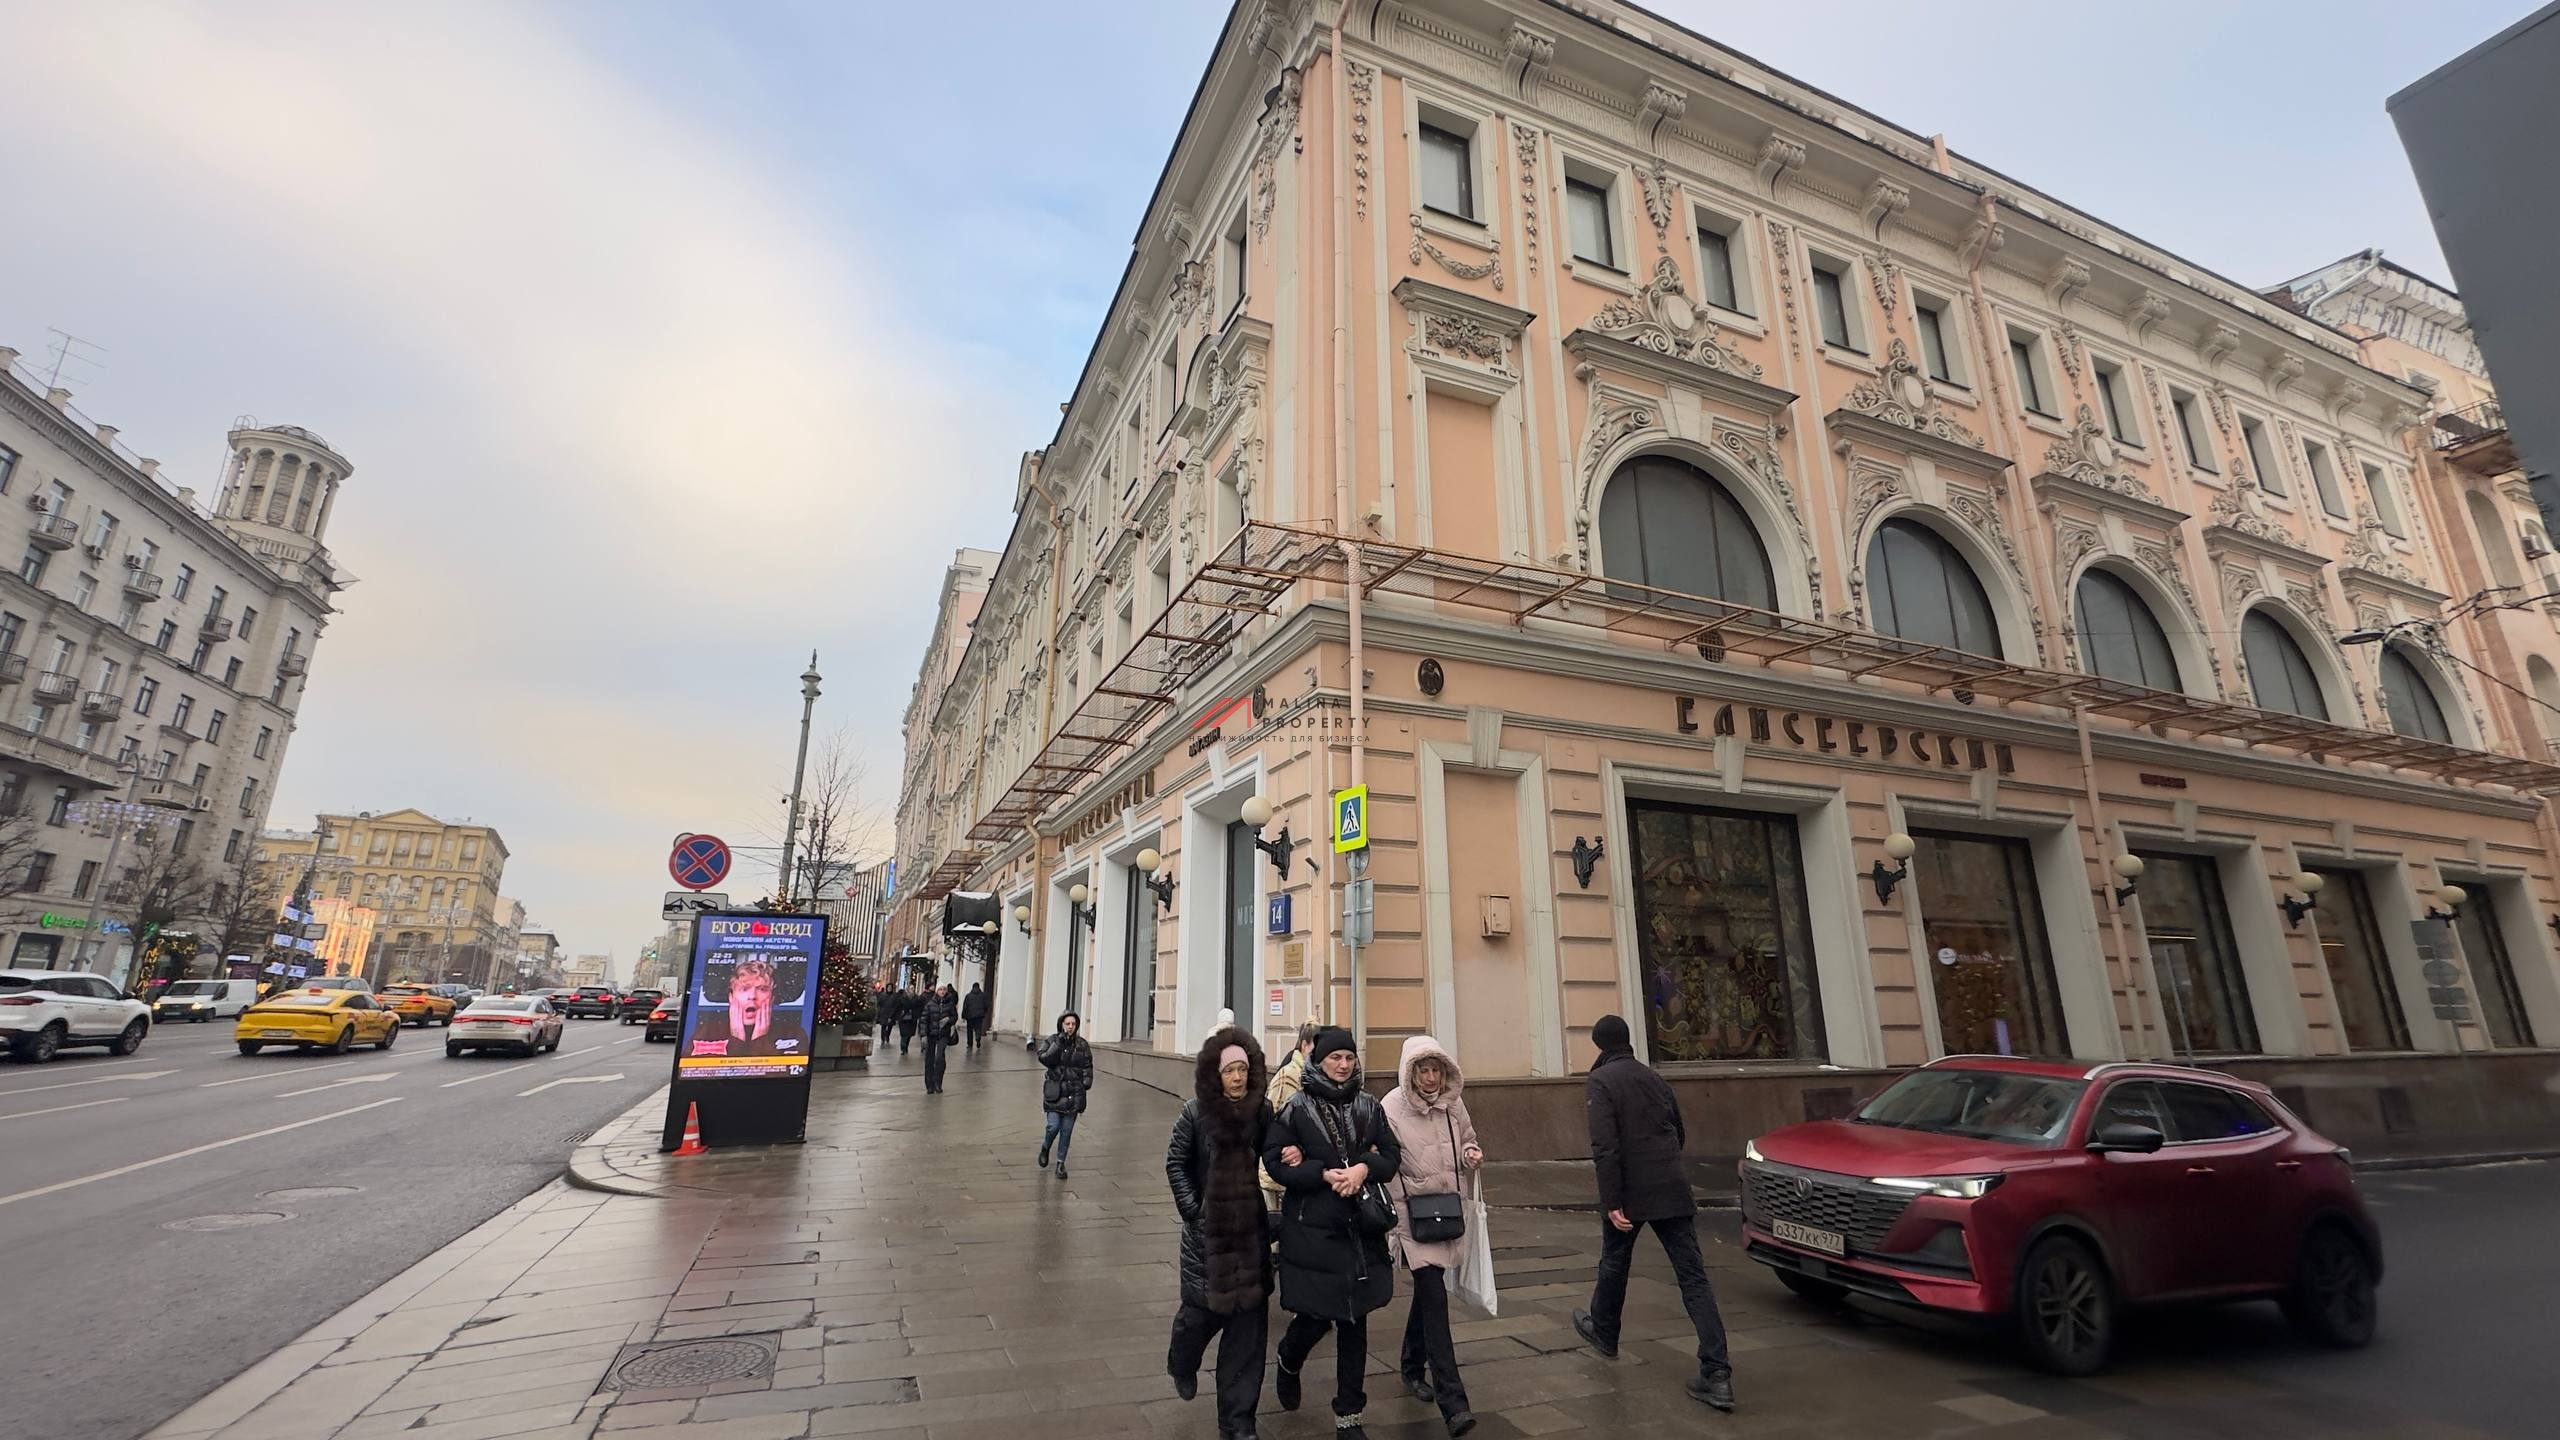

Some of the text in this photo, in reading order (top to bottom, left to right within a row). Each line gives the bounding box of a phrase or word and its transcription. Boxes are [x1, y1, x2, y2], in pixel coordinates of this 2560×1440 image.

[1271, 904, 1283, 925] 14
[711, 920, 812, 937] ЕГОР КРИД
[789, 1065, 804, 1075] 12+
